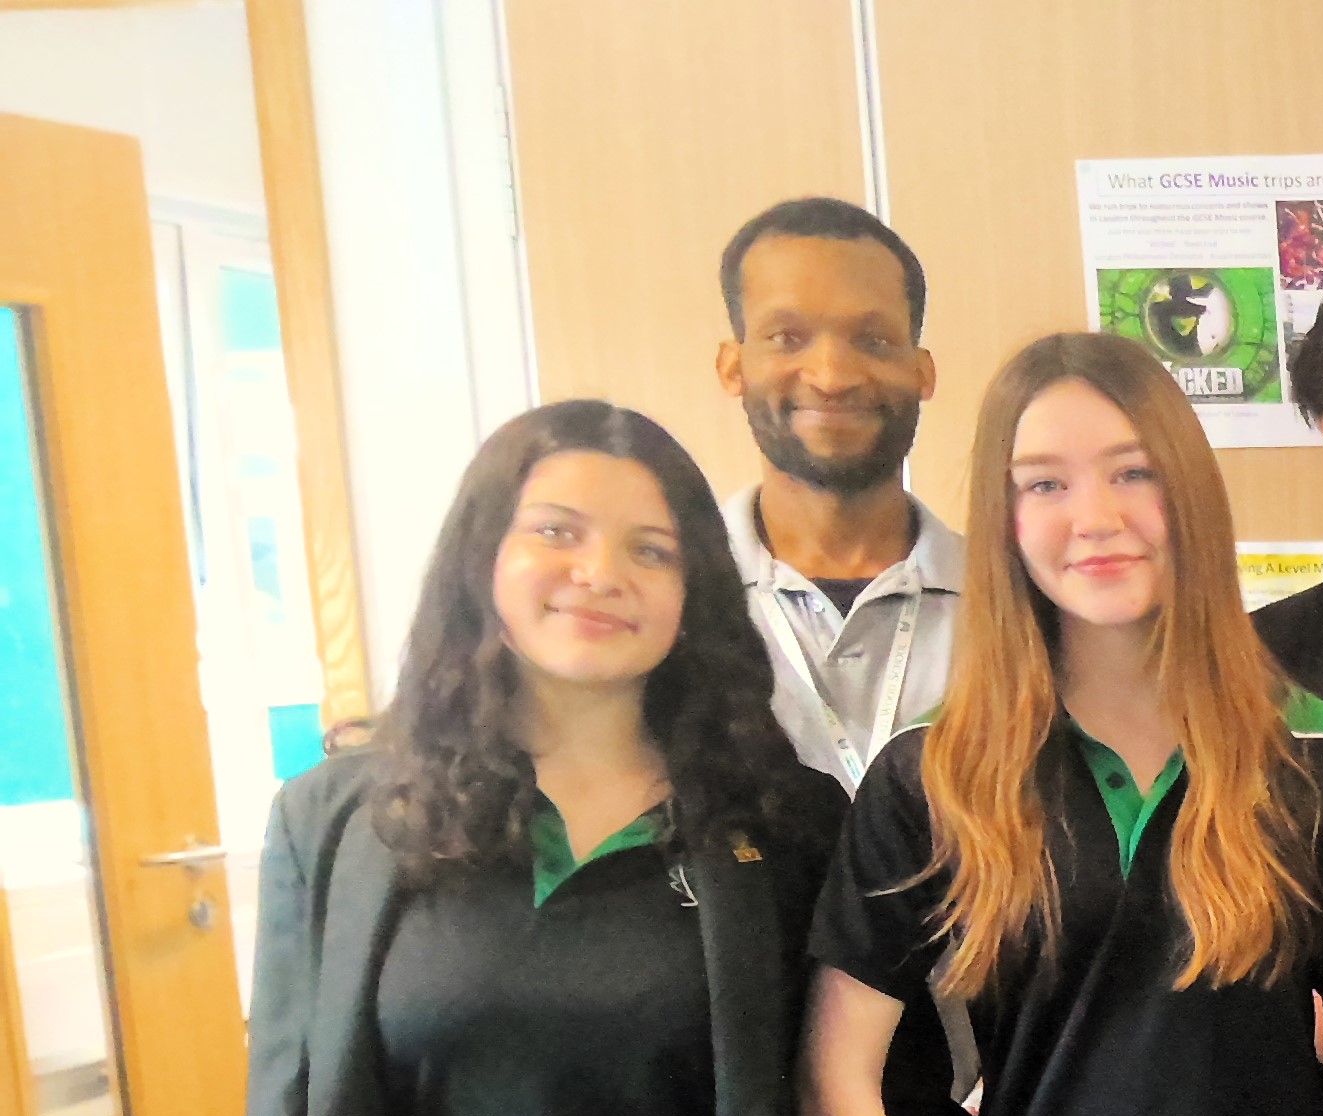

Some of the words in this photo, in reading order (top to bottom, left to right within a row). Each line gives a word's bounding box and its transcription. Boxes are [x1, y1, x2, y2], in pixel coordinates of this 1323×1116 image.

[1107, 173, 1154, 189] What
[1159, 172, 1203, 189] GCSE
[1208, 172, 1259, 188] Music
[1264, 172, 1303, 192] trips
[1265, 563, 1275, 573] A
[1278, 563, 1312, 574] Level
